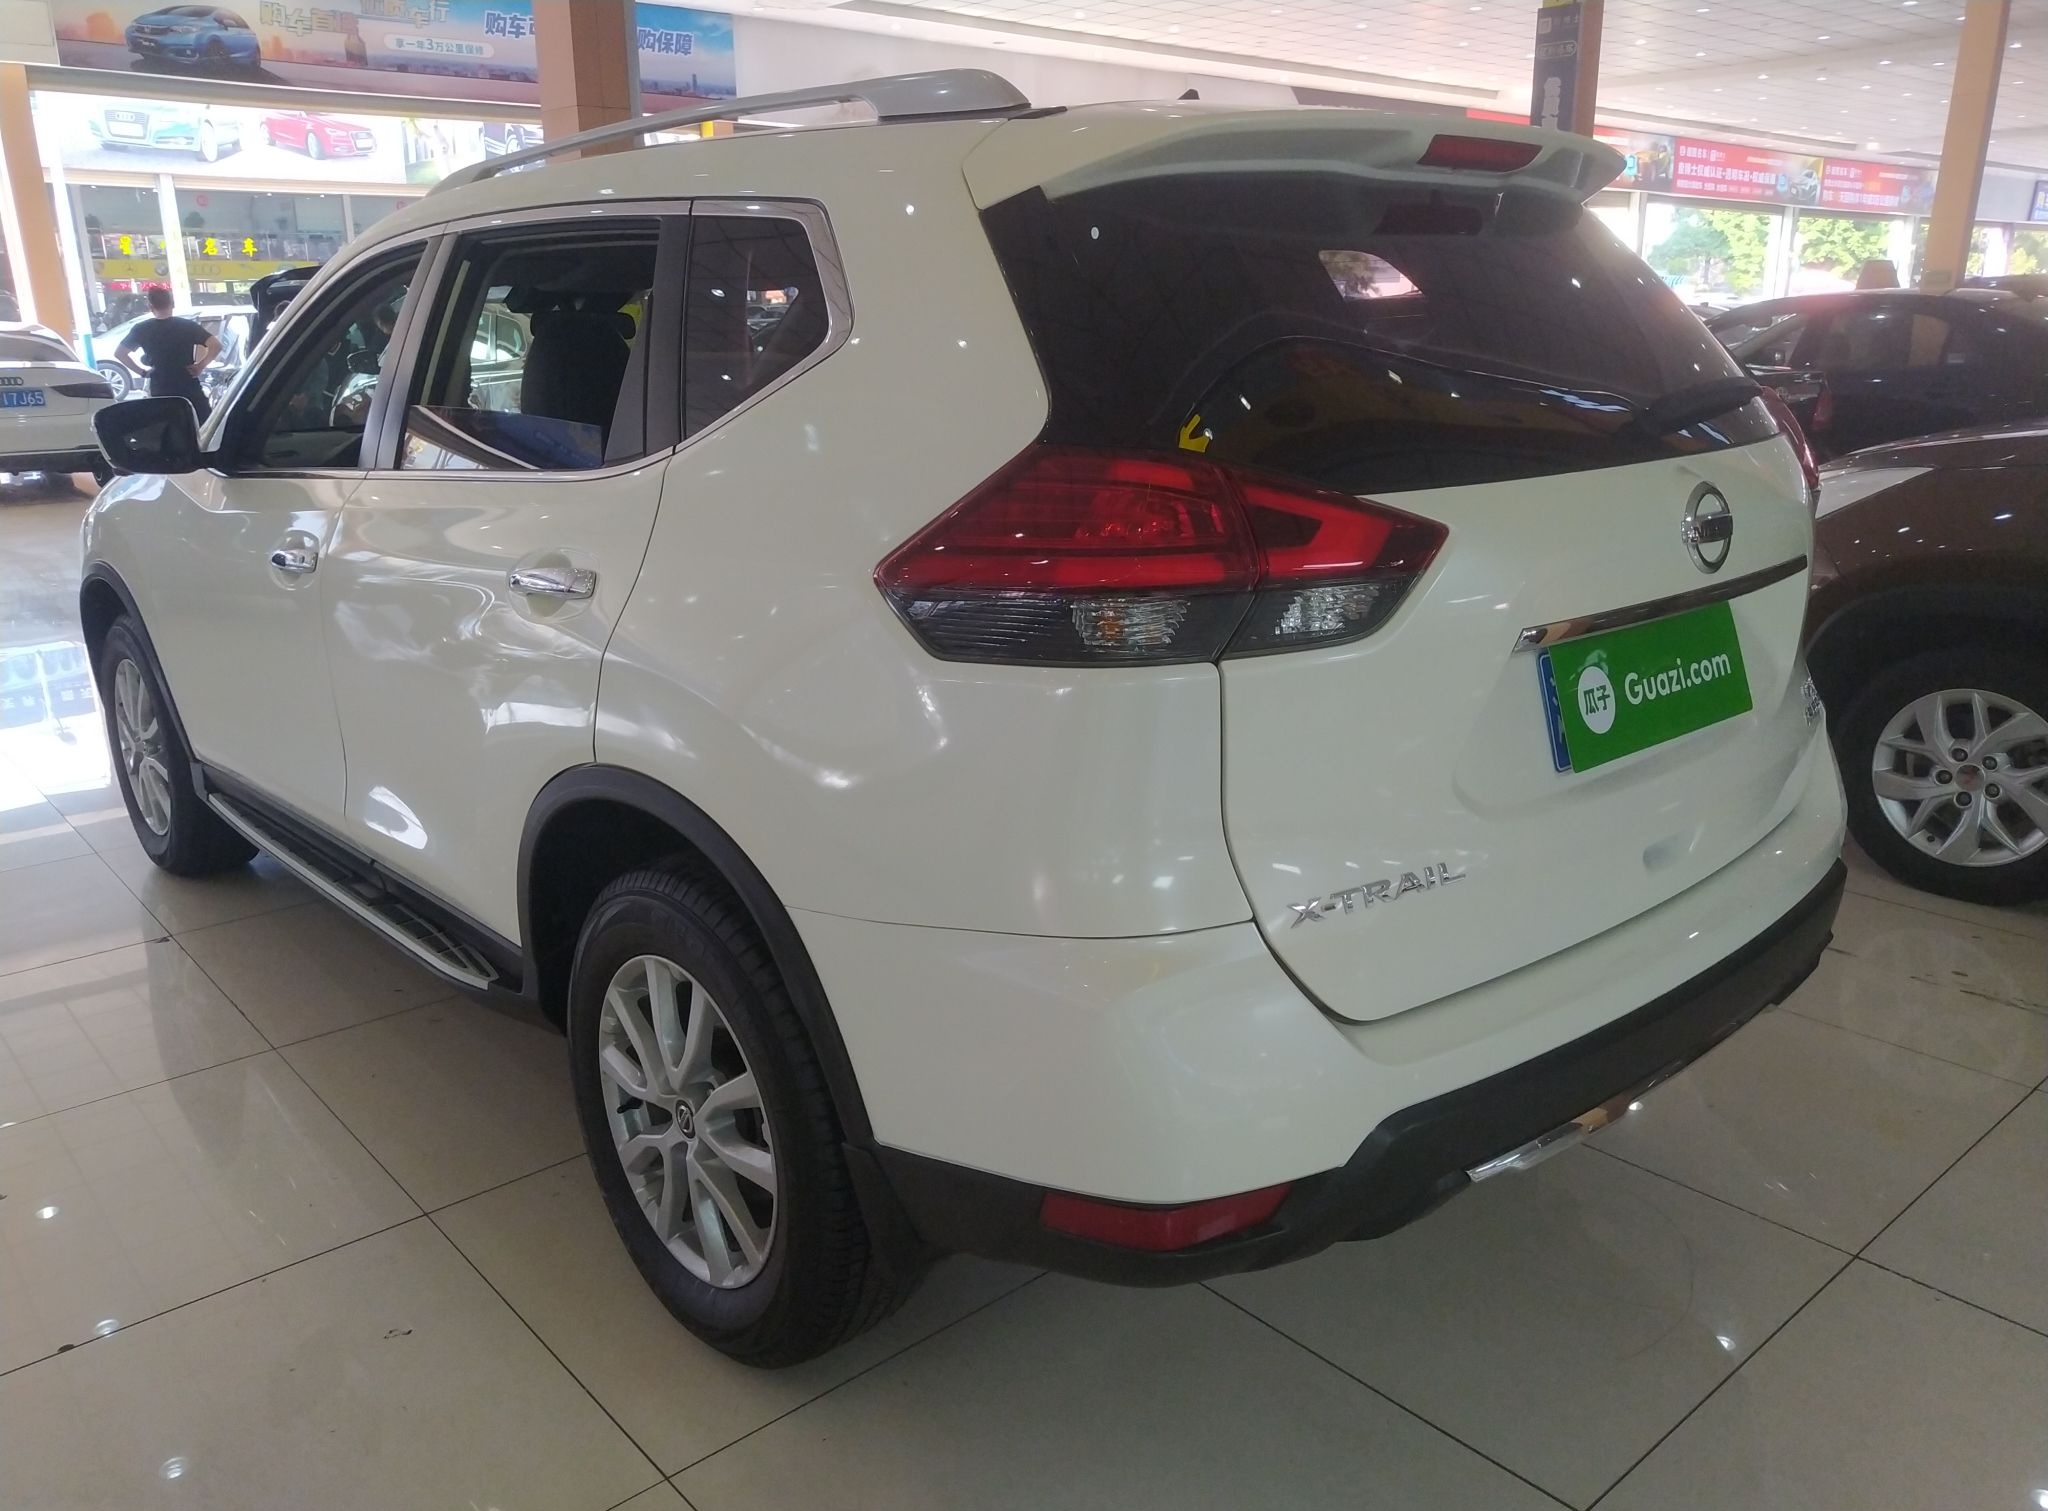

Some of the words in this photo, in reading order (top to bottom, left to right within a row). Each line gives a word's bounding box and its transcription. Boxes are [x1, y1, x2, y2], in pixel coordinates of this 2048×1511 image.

[638, 29, 692, 56] 购保障
[1624, 650, 1732, 706] Guazi.com
[1583, 685, 1611, 717] 瓜子
[1286, 862, 1467, 929] X-TRAIL
